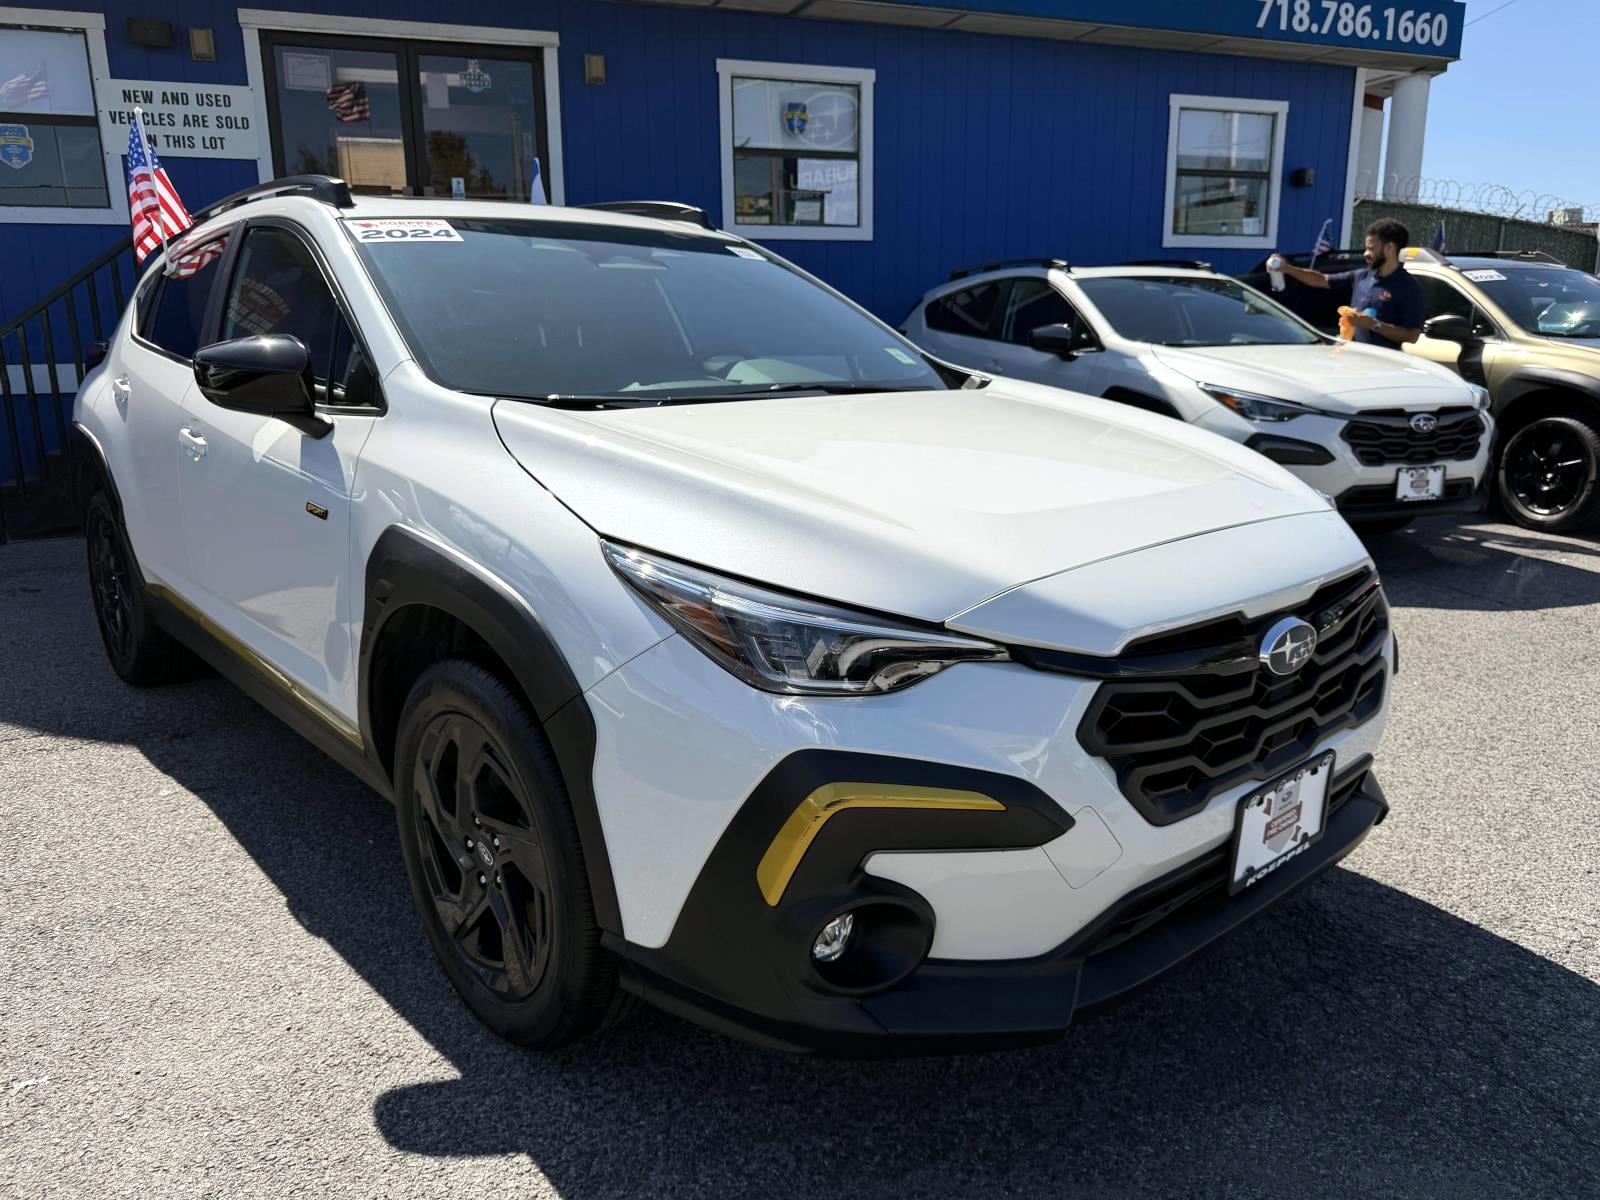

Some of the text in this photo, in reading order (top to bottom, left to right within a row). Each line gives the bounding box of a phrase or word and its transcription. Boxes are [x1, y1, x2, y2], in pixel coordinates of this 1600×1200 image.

[1255, 0, 1449, 47] 718.786.1660
[122, 89, 232, 108] NEW AND USED
[109, 110, 250, 130] VEHCLES ARE SOLD
[163, 135, 196, 149] THIS
[202, 136, 226, 150] LOT
[360, 229, 457, 240] 2024
[1246, 841, 1311, 887] KOEPPEL
